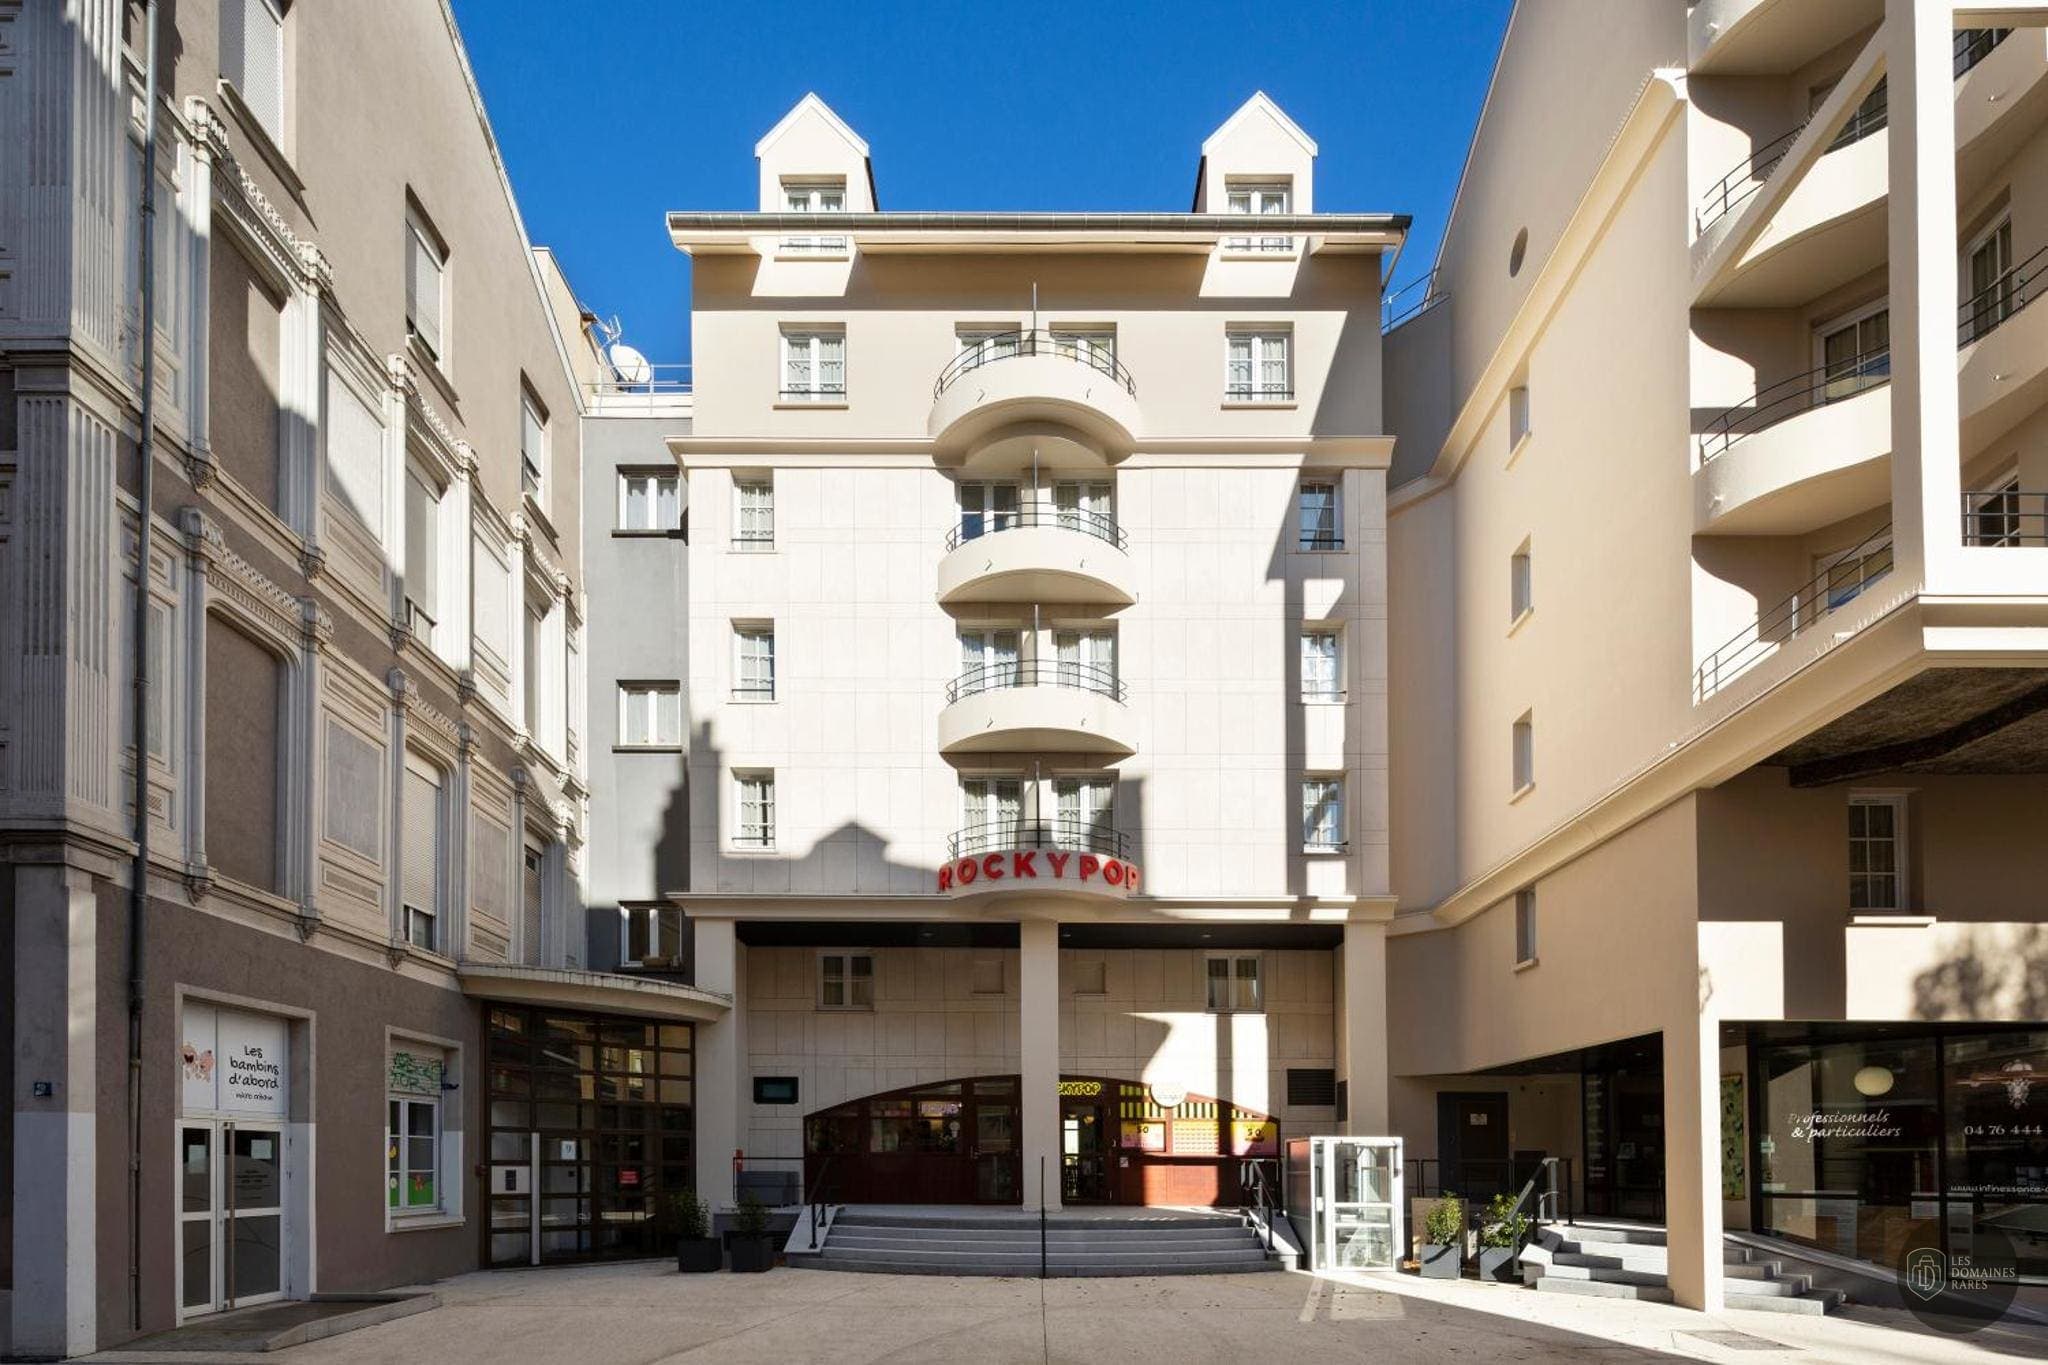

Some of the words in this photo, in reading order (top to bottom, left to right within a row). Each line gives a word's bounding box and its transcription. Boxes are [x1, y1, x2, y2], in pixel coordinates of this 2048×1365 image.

[938, 851, 1138, 892] ROCKYPOP
[244, 1045, 263, 1058] Les
[230, 1056, 279, 1075] bambins
[229, 1073, 279, 1089] d'abord
[1787, 1109, 1890, 1129] Professionnels
[1791, 1127, 1804, 1138] &
[1806, 1123, 1901, 1143] particuliers
[1964, 1124, 1984, 1135] 04
[1988, 1124, 2005, 1135] 76
